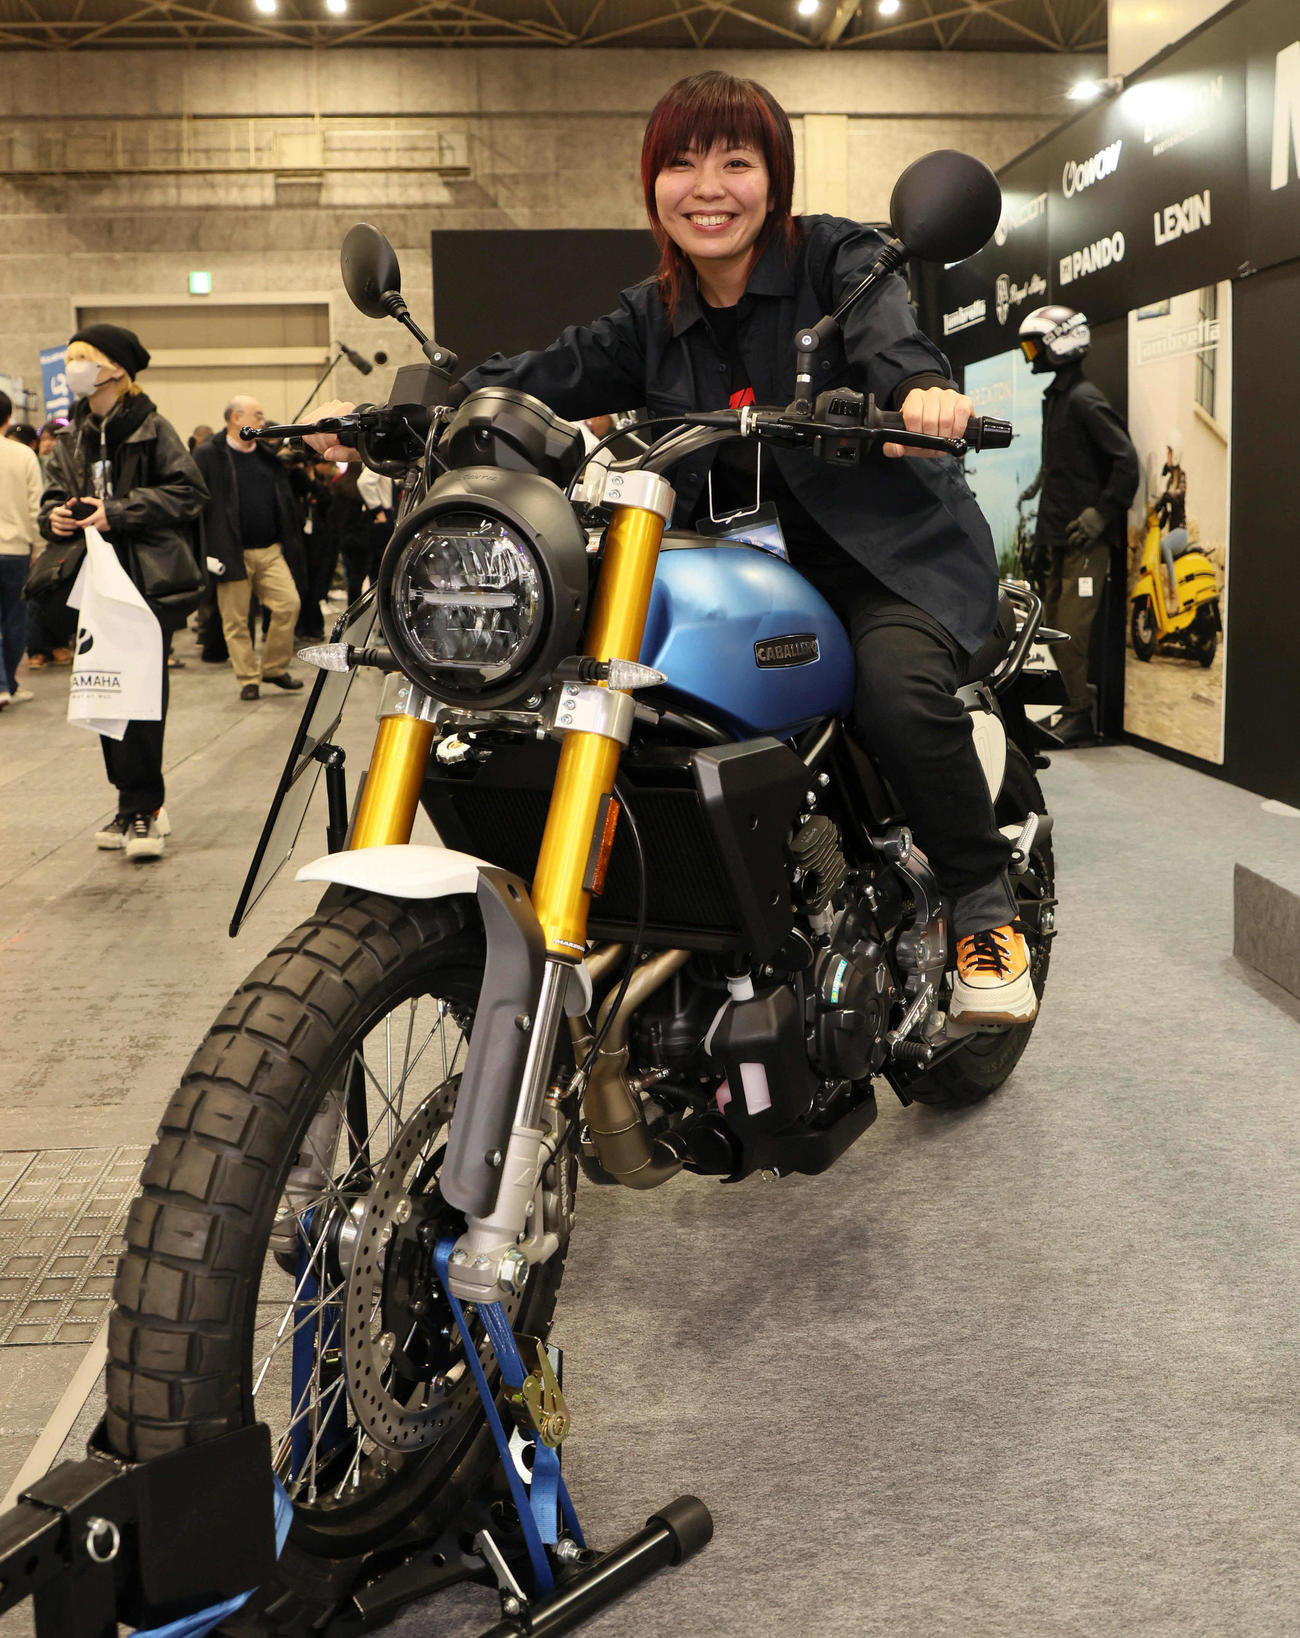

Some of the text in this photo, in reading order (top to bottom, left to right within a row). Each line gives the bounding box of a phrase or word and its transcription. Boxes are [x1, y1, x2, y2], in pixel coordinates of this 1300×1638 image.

[1153, 189, 1212, 246] LEXIN
[1072, 231, 1126, 280] PANDO
[72, 675, 121, 688] AMAHA
